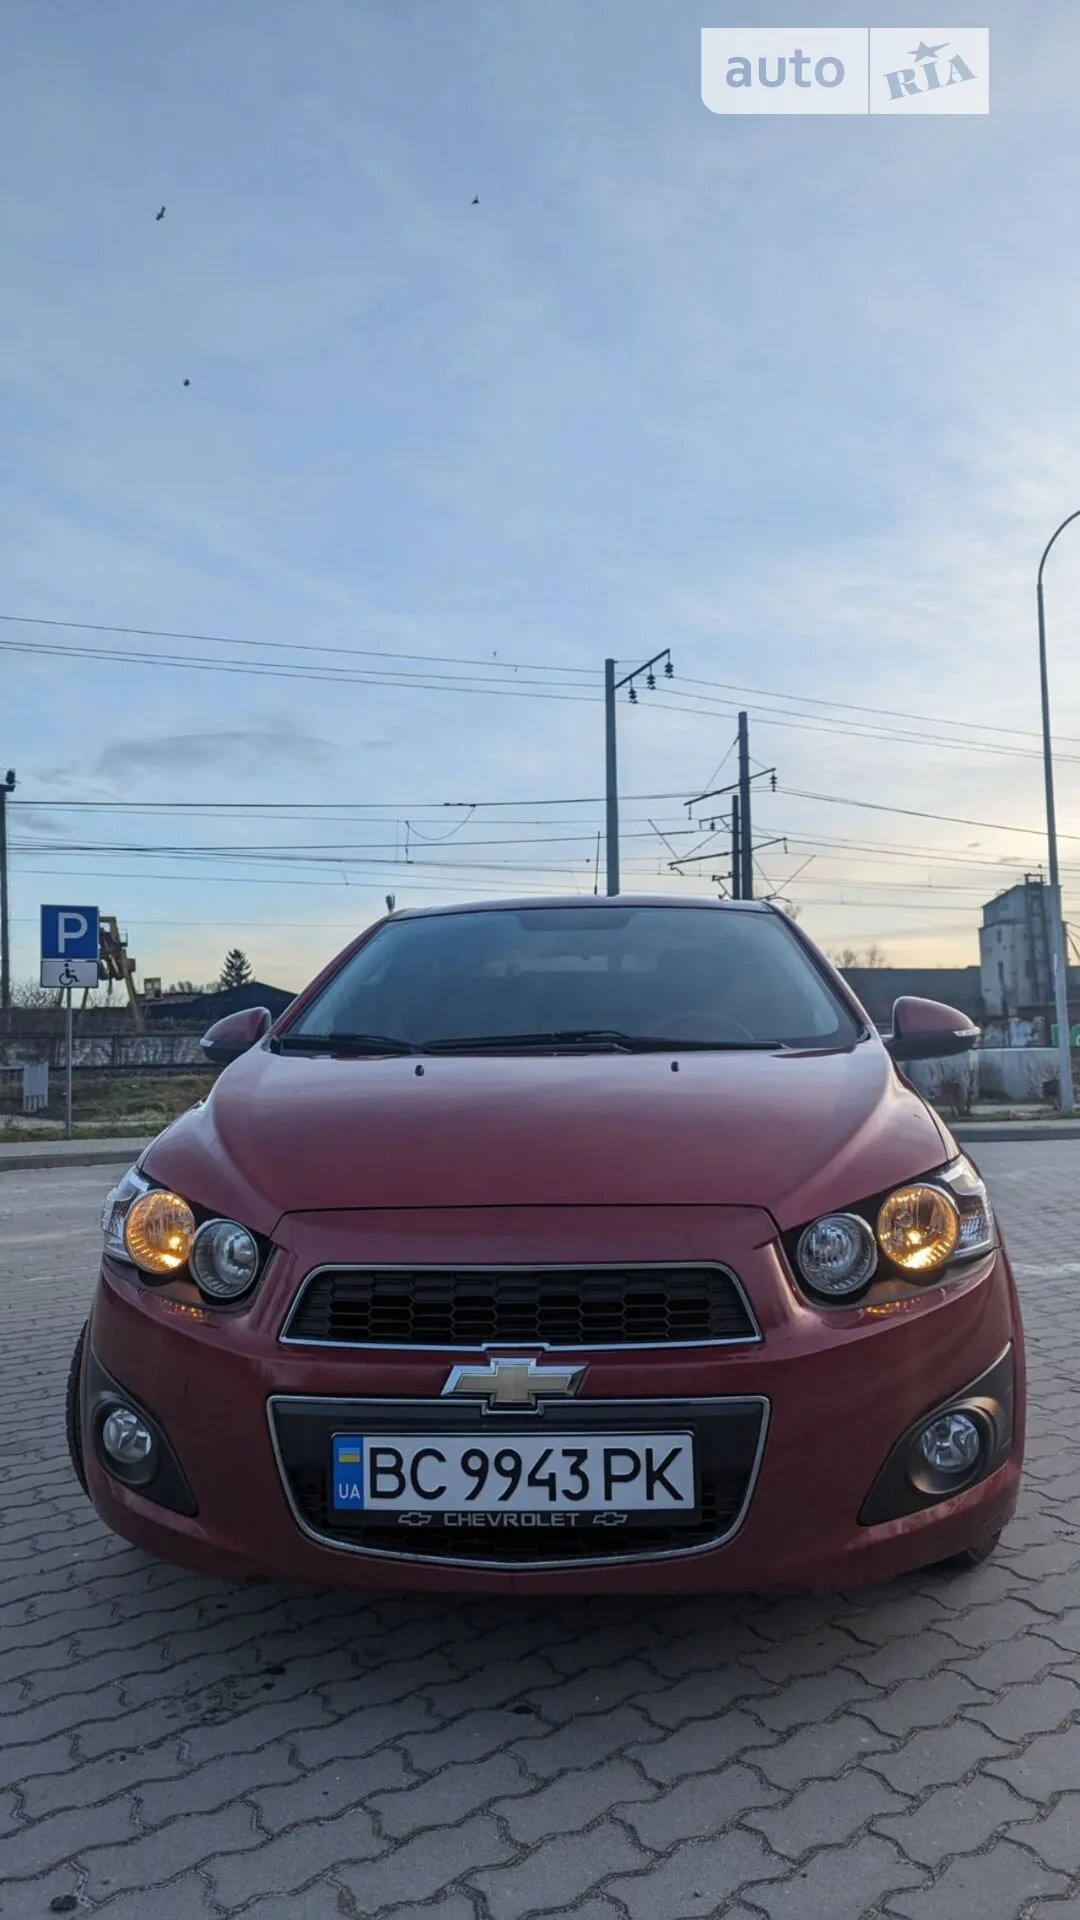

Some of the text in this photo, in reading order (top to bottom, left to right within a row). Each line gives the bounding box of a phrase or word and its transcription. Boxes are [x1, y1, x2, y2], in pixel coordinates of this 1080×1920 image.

[58, 912, 88, 953] P
[369, 1446, 684, 1501] BC 9943 PK
[338, 1483, 361, 1500] UA
[444, 1512, 580, 1527] CHEVROLET
